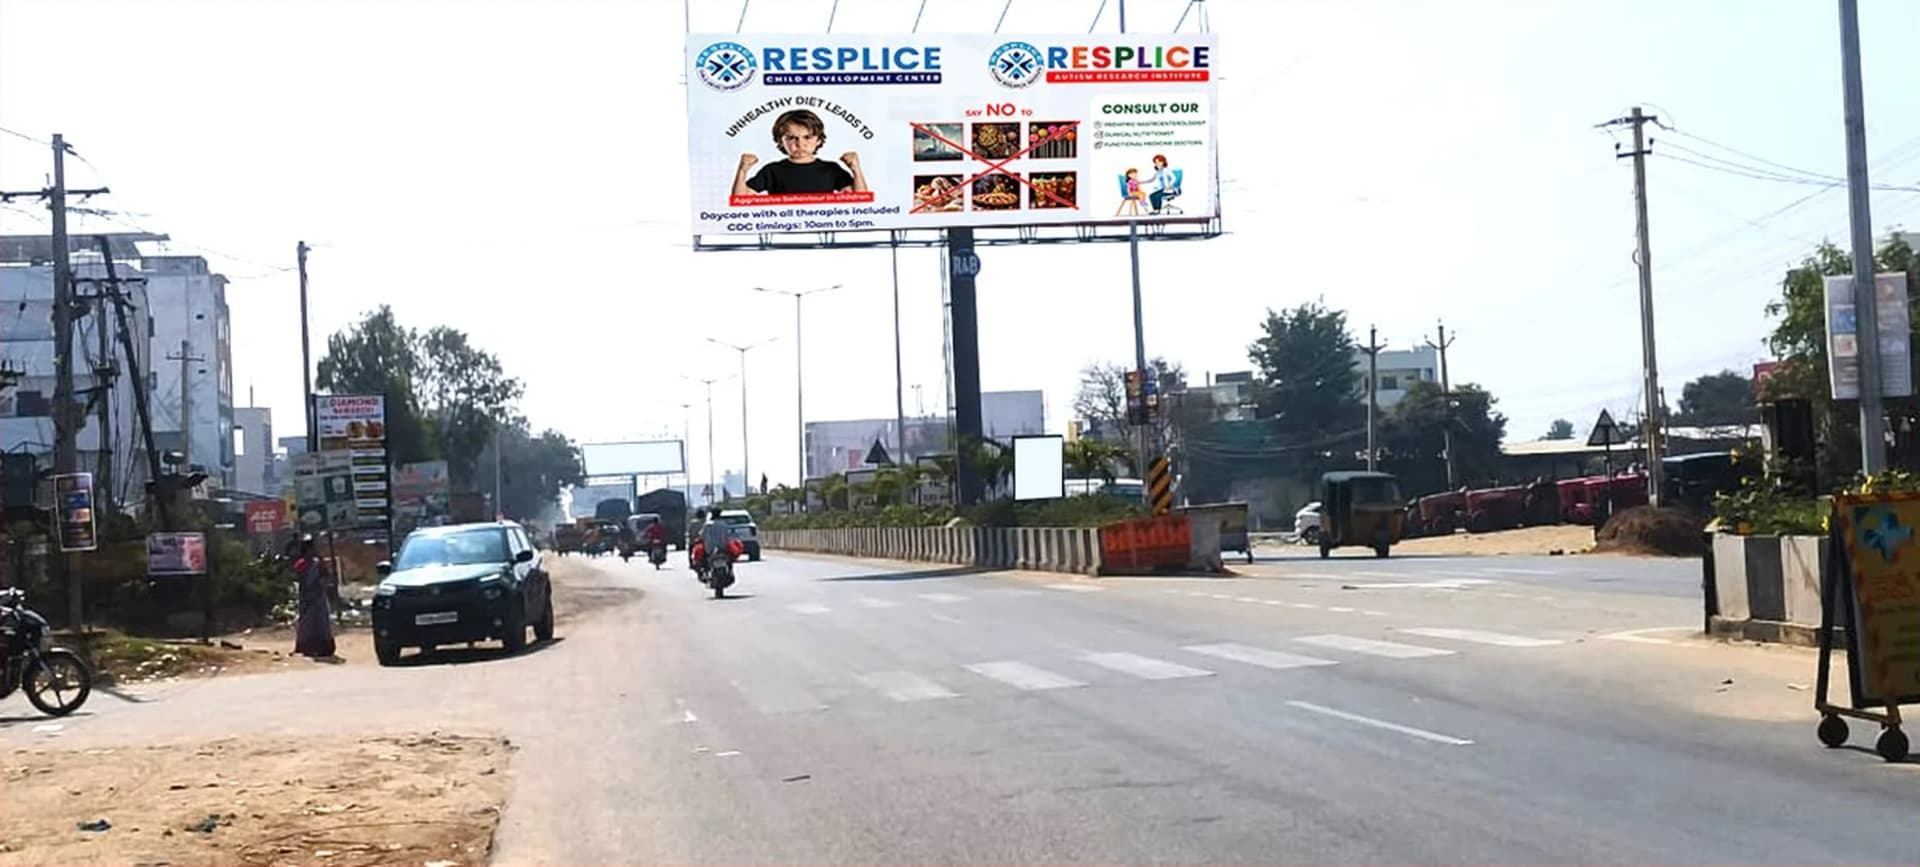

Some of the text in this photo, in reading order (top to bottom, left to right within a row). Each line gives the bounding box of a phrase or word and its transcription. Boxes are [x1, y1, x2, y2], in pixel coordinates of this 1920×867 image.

[763, 47, 941, 70] RESPLICE
[1048, 46, 1209, 69] RESPLICE
[766, 75, 802, 83] CHILD
[807, 74, 891, 82] DEVELOPMENT
[1151, 72, 1201, 80] INSTITUTE
[965, 103, 1033, 117] SAY NO TO
[1102, 103, 1199, 115] CONSULT OUR
[725, 95, 874, 140] UNHEALTHY DIET LEADS TO
[734, 196, 780, 205] Aggressive
[782, 195, 825, 203] behaviour
[836, 193, 871, 201] children
[700, 206, 900, 222] Daycare with all therapies included
[756, 221, 802, 231] timings:
[804, 220, 833, 229] 10am
[835, 220, 847, 228] to
[330, 398, 379, 407] DIAMOND
